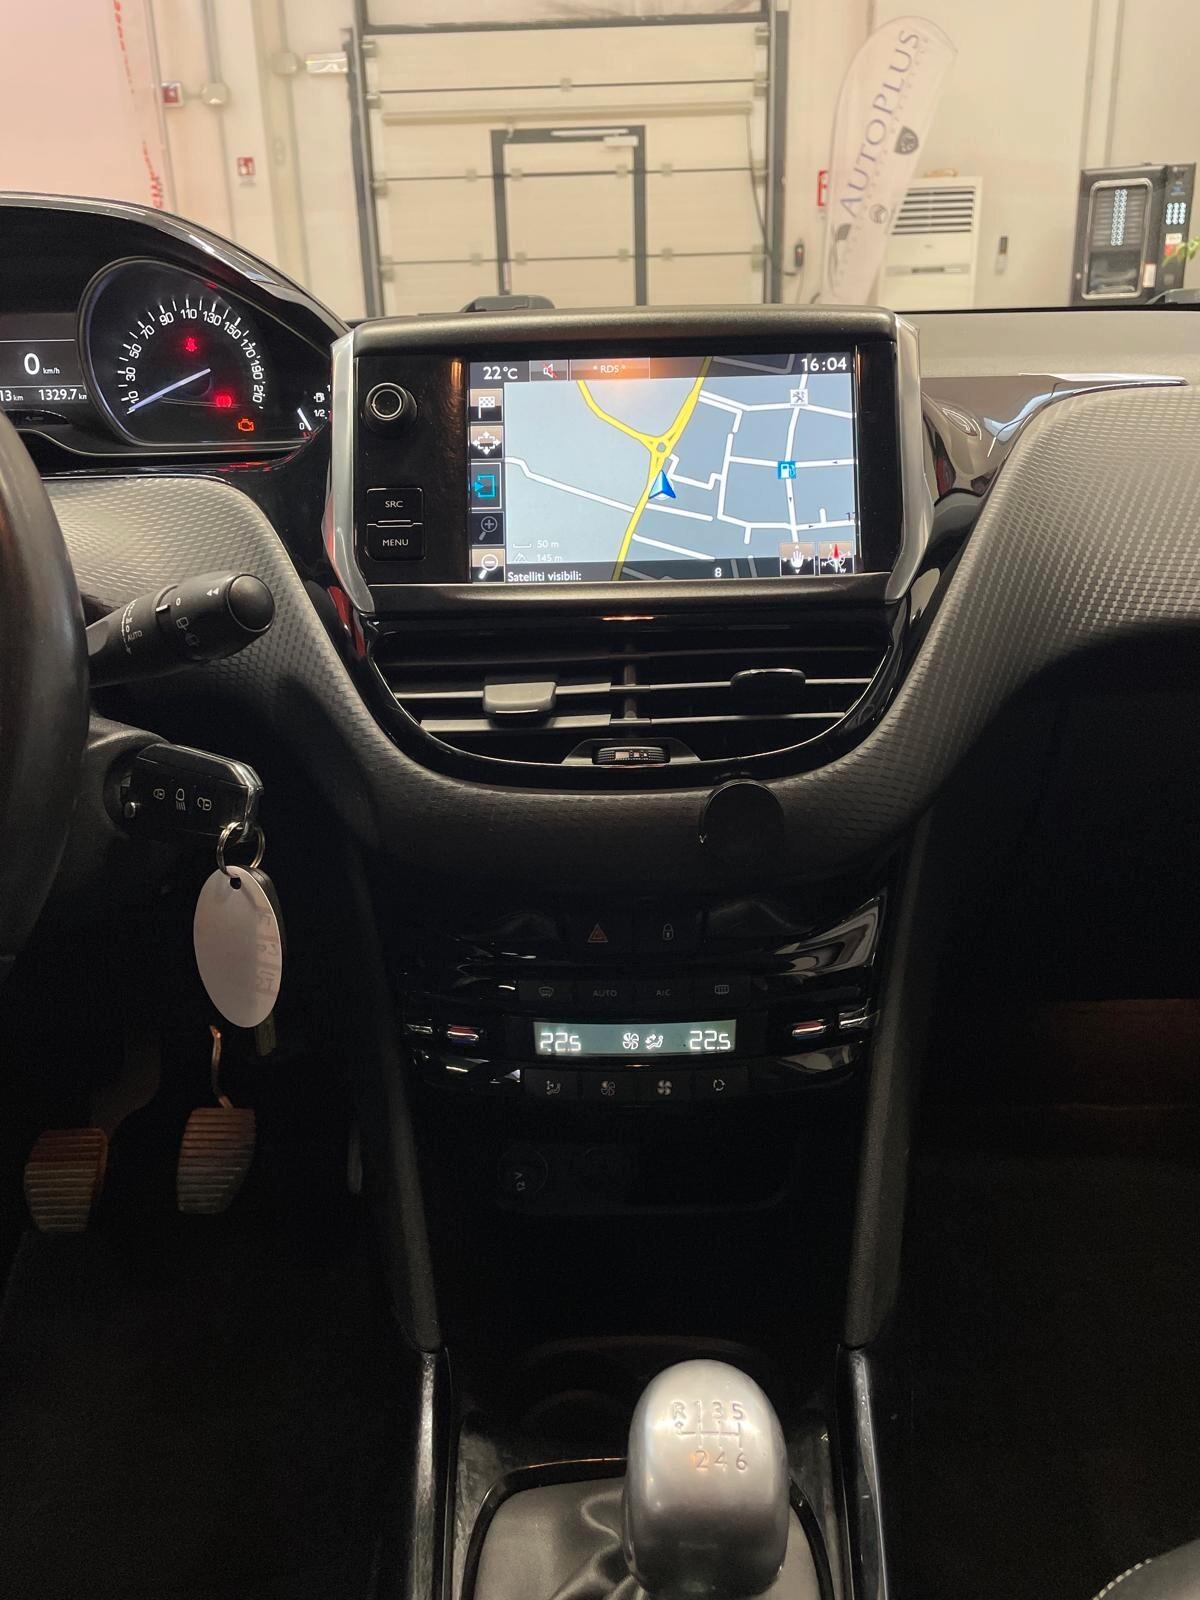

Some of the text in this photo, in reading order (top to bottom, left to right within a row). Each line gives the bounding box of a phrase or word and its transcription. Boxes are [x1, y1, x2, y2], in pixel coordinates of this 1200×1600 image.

[839, 30, 921, 218] AUTOPLUS
[159, 312, 174, 326] 90
[180, 308, 198, 320] 110
[203, 311, 222, 326] 130
[140, 324, 155, 340] 70
[224, 321, 242, 340] 150
[129, 343, 142, 359] 50
[240, 339, 256, 358] 170
[24, 352, 61, 375] 0 km/h
[251, 359, 265, 380] 190
[600, 365, 620, 374] RDS
[801, 356, 847, 372] 16:04
[125, 366, 136, 382] 30
[38, 388, 78, 401] 1329.7
[128, 390, 140, 404] 10
[252, 384, 266, 404] 210
[313, 409, 326, 418] 1/2
[298, 422, 305, 430] 0
[384, 500, 404, 508] SRC
[382, 538, 409, 547] MENU
[536, 539, 560, 549] 50 m
[536, 553, 553, 562] 145
[507, 570, 582, 582] Satelliti visibili:
[714, 567, 722, 578] 8
[127, 630, 143, 642] AUTO
[592, 989, 618, 999] AUTO
[655, 988, 672, 998] A/C
[671, 1401, 687, 1420] R
[712, 1401, 725, 1419] 3
[732, 1402, 745, 1421] 5
[695, 1450, 748, 1471] 2 4 6
